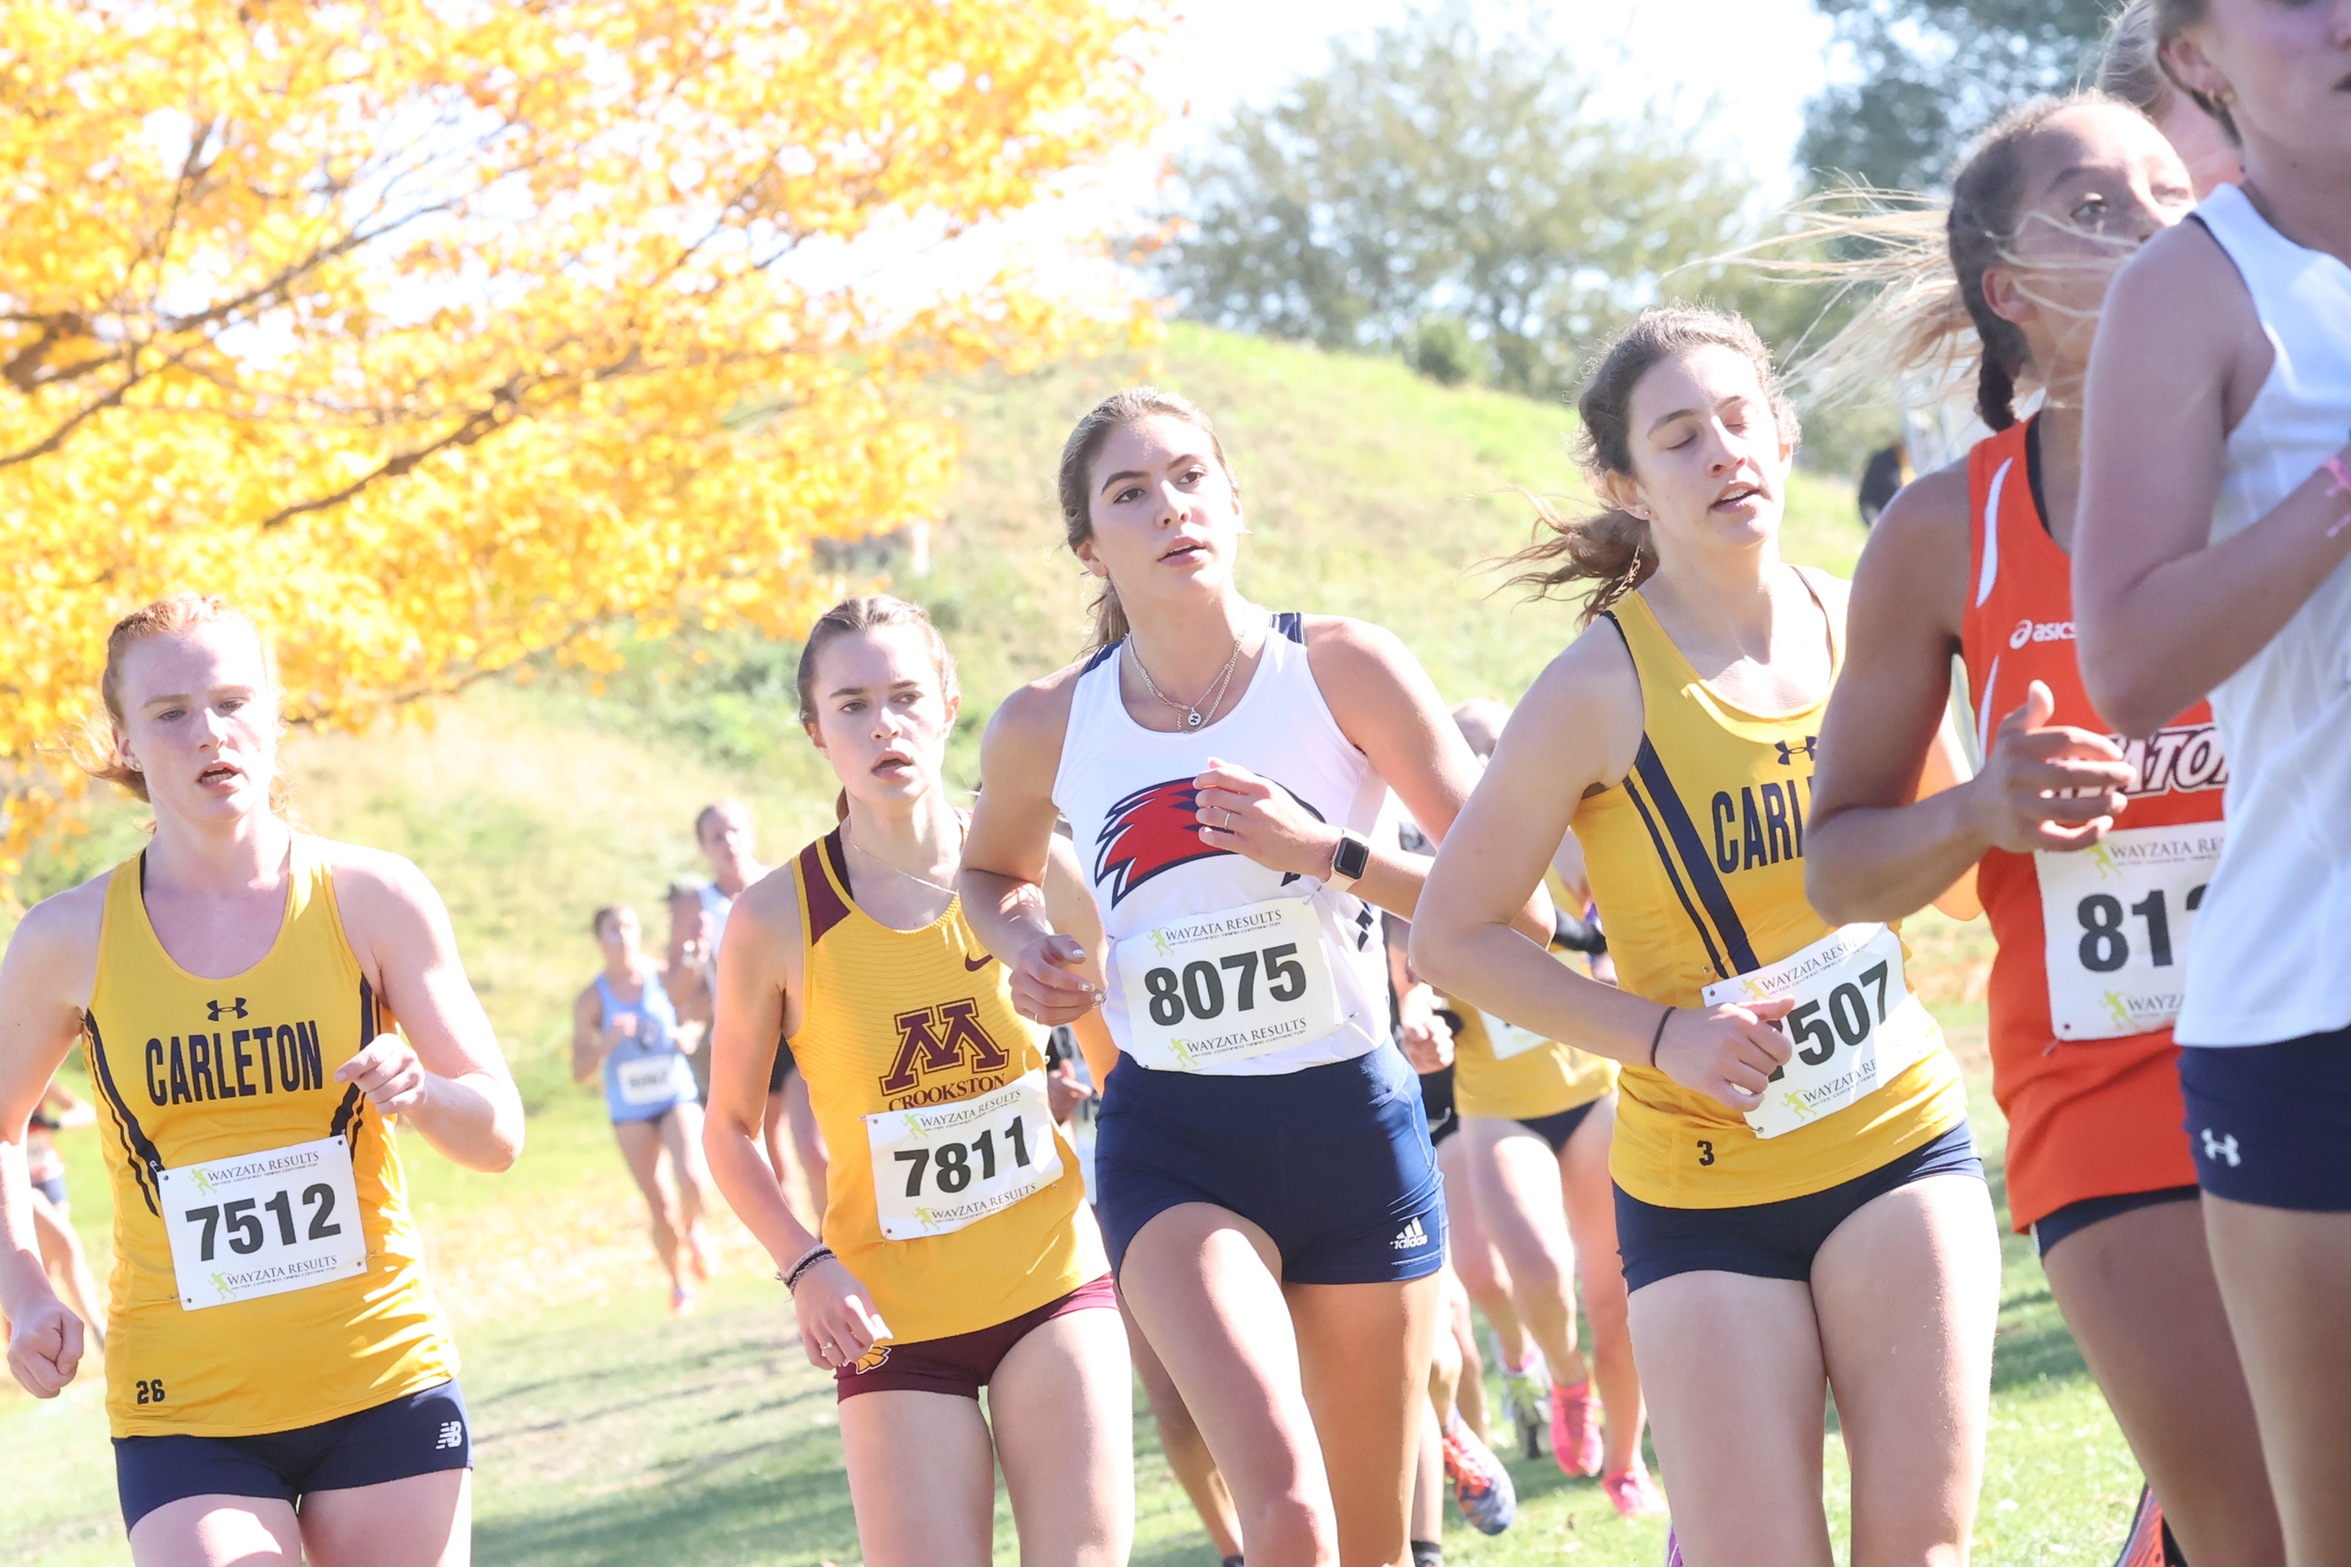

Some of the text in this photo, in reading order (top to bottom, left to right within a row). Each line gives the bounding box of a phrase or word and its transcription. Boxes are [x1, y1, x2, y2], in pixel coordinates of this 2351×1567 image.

[2110, 841, 2189, 859] WAYZATA
[1166, 909, 1282, 942] WAYZATA RESULTS
[1144, 942, 1307, 1026] 8075
[1762, 957, 1820, 991] WAYZATA
[879, 997, 1009, 1097] M
[1187, 1017, 1307, 1053] WAYZATA RESULTS
[145, 1020, 323, 1107] CARLETON
[888, 1073, 1005, 1112] CROOKSTON
[1803, 1070, 1860, 1103] WAYZATA
[920, 1109, 975, 1127] WAYZATA
[978, 1089, 1021, 1113] RESULTS
[207, 1162, 265, 1182] WAYZATA
[269, 1151, 320, 1168] RESULTS
[894, 1115, 1031, 1198] 7811
[1697, 1140, 1715, 1166] 3
[931, 1201, 988, 1219] WAYZATA
[990, 1183, 1037, 1206] RESULTS
[185, 1182, 341, 1262] 7512
[227, 1266, 286, 1286] WAYZATA
[289, 1255, 338, 1273] RESULTS
[136, 1379, 165, 1405] 26
